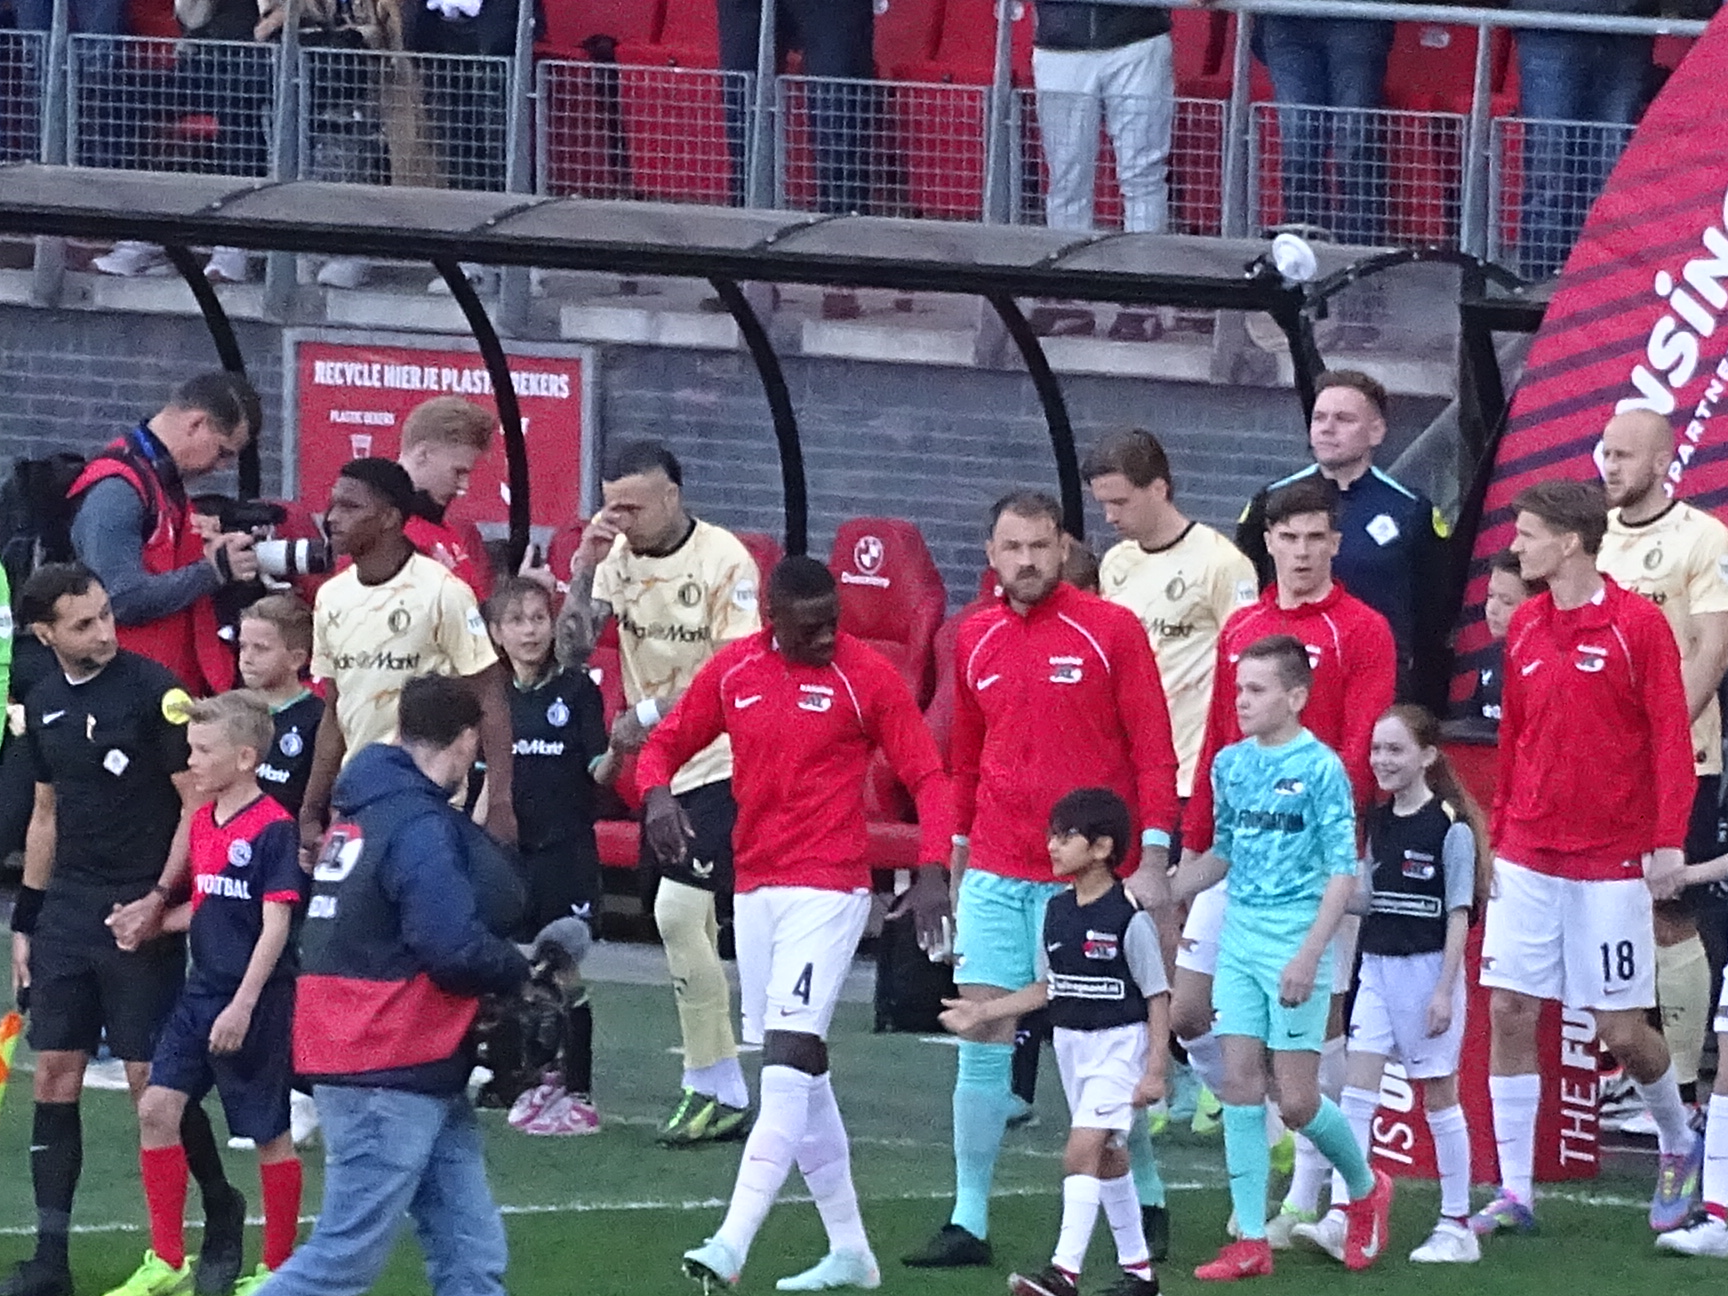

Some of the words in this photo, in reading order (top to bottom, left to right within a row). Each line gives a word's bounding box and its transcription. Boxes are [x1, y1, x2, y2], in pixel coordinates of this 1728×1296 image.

[314, 360, 382, 388] RECYCLE
[384, 365, 422, 390] HIER
[422, 368, 439, 392] JE
[441, 367, 495, 396] PLAST
[1599, 939, 1635, 982] 18
[791, 962, 814, 1006] 4
[1561, 1006, 1597, 1071] FU
[1371, 1116, 1414, 1165] IS
[1559, 1077, 1596, 1167] THE
